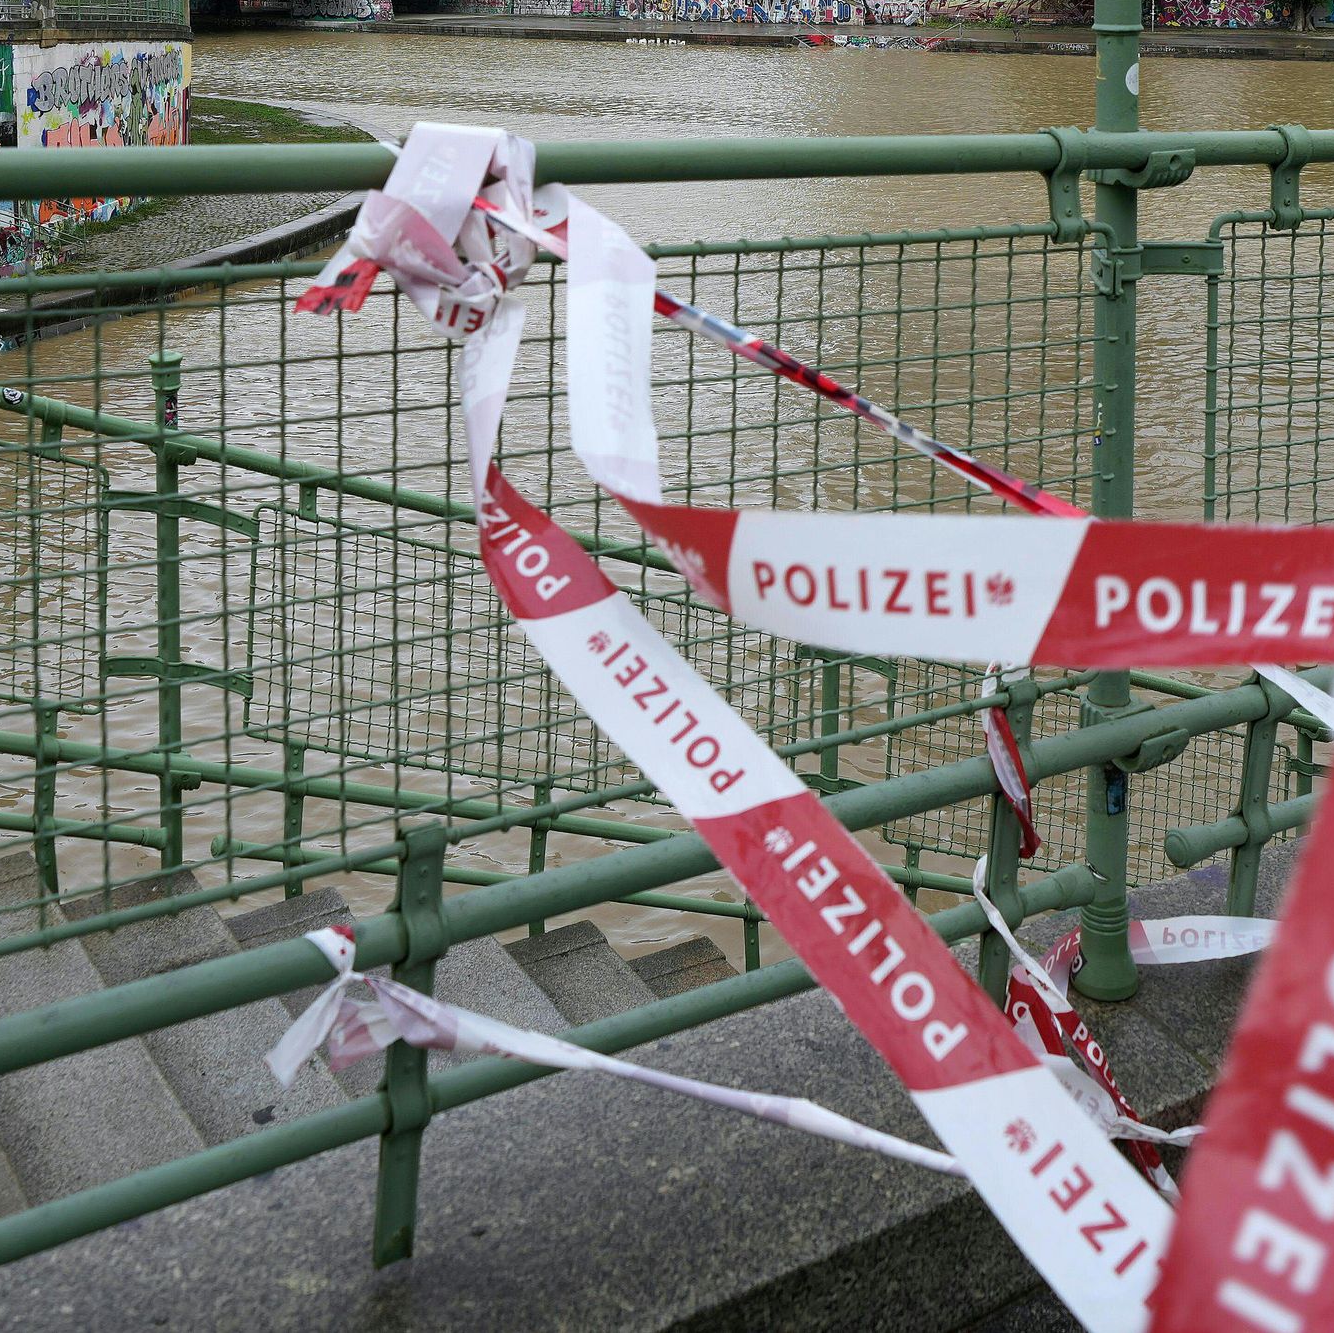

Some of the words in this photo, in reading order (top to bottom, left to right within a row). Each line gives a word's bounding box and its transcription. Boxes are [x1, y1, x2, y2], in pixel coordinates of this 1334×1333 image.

[752, 560, 976, 618] POLIZEI
[602, 640, 744, 796] POLIZEI
[781, 840, 969, 1061] POLIZEI
